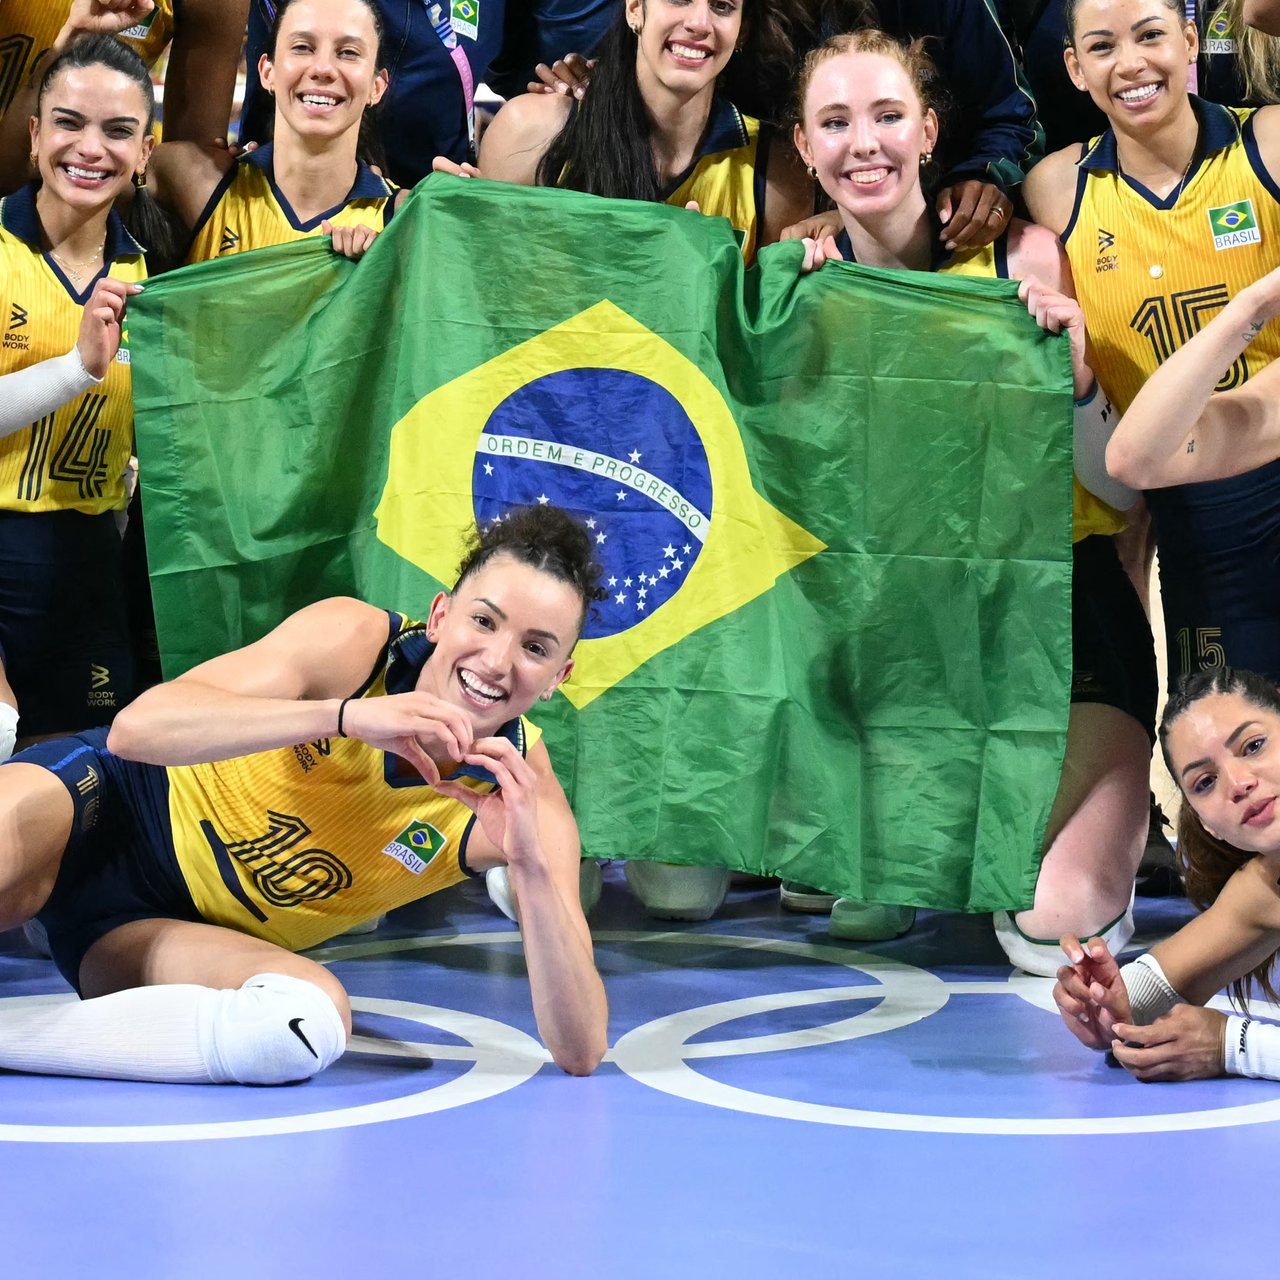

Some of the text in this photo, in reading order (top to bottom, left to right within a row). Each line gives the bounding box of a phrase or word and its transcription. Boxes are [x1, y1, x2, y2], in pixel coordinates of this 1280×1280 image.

[451, 19, 477, 39] BRASIL
[1215, 230, 1260, 249] BRASIL
[1095, 263, 1119, 273] WORK
[1096, 255, 1118, 265] BODY
[2, 341, 30, 351] WORK
[4, 333, 30, 343] BODY
[1130, 283, 1248, 391] 15
[17, 394, 108, 502] 14
[486, 434, 702, 530] ORDEM E PROGRESSO
[1175, 627, 1226, 673] 15
[87, 699, 116, 708] WORK
[88, 691, 115, 700] BODY
[293, 745, 311, 773] WORK
[297, 742, 318, 768] BODY
[384, 841, 424, 873] BRASIL
